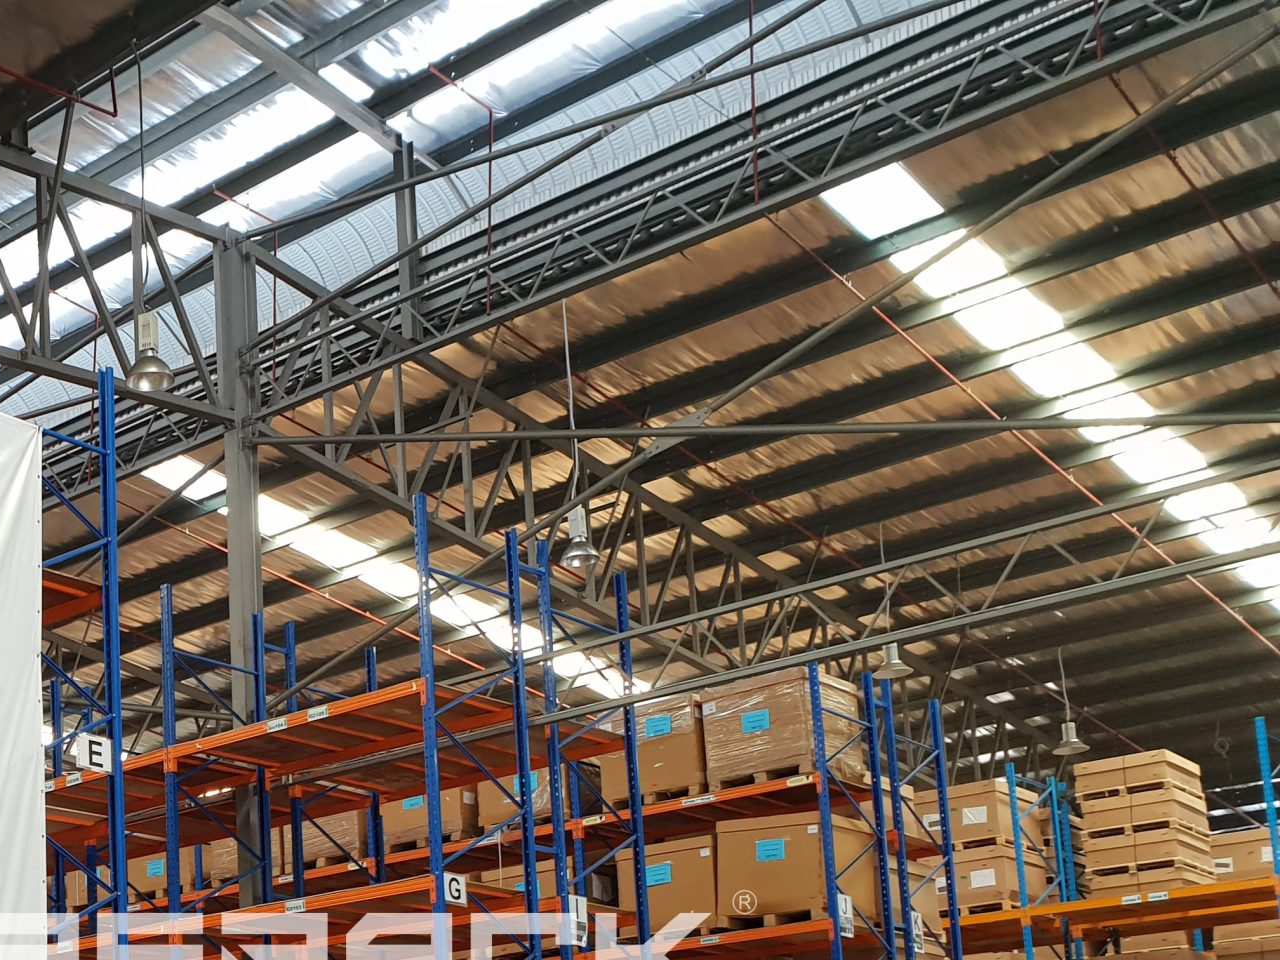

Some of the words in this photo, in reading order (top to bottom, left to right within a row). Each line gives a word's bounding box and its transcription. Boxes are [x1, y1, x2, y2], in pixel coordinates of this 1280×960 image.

[88, 739, 104, 769] E
[448, 876, 462, 901] G
[841, 897, 848, 915] J
[913, 914, 921, 932] K
